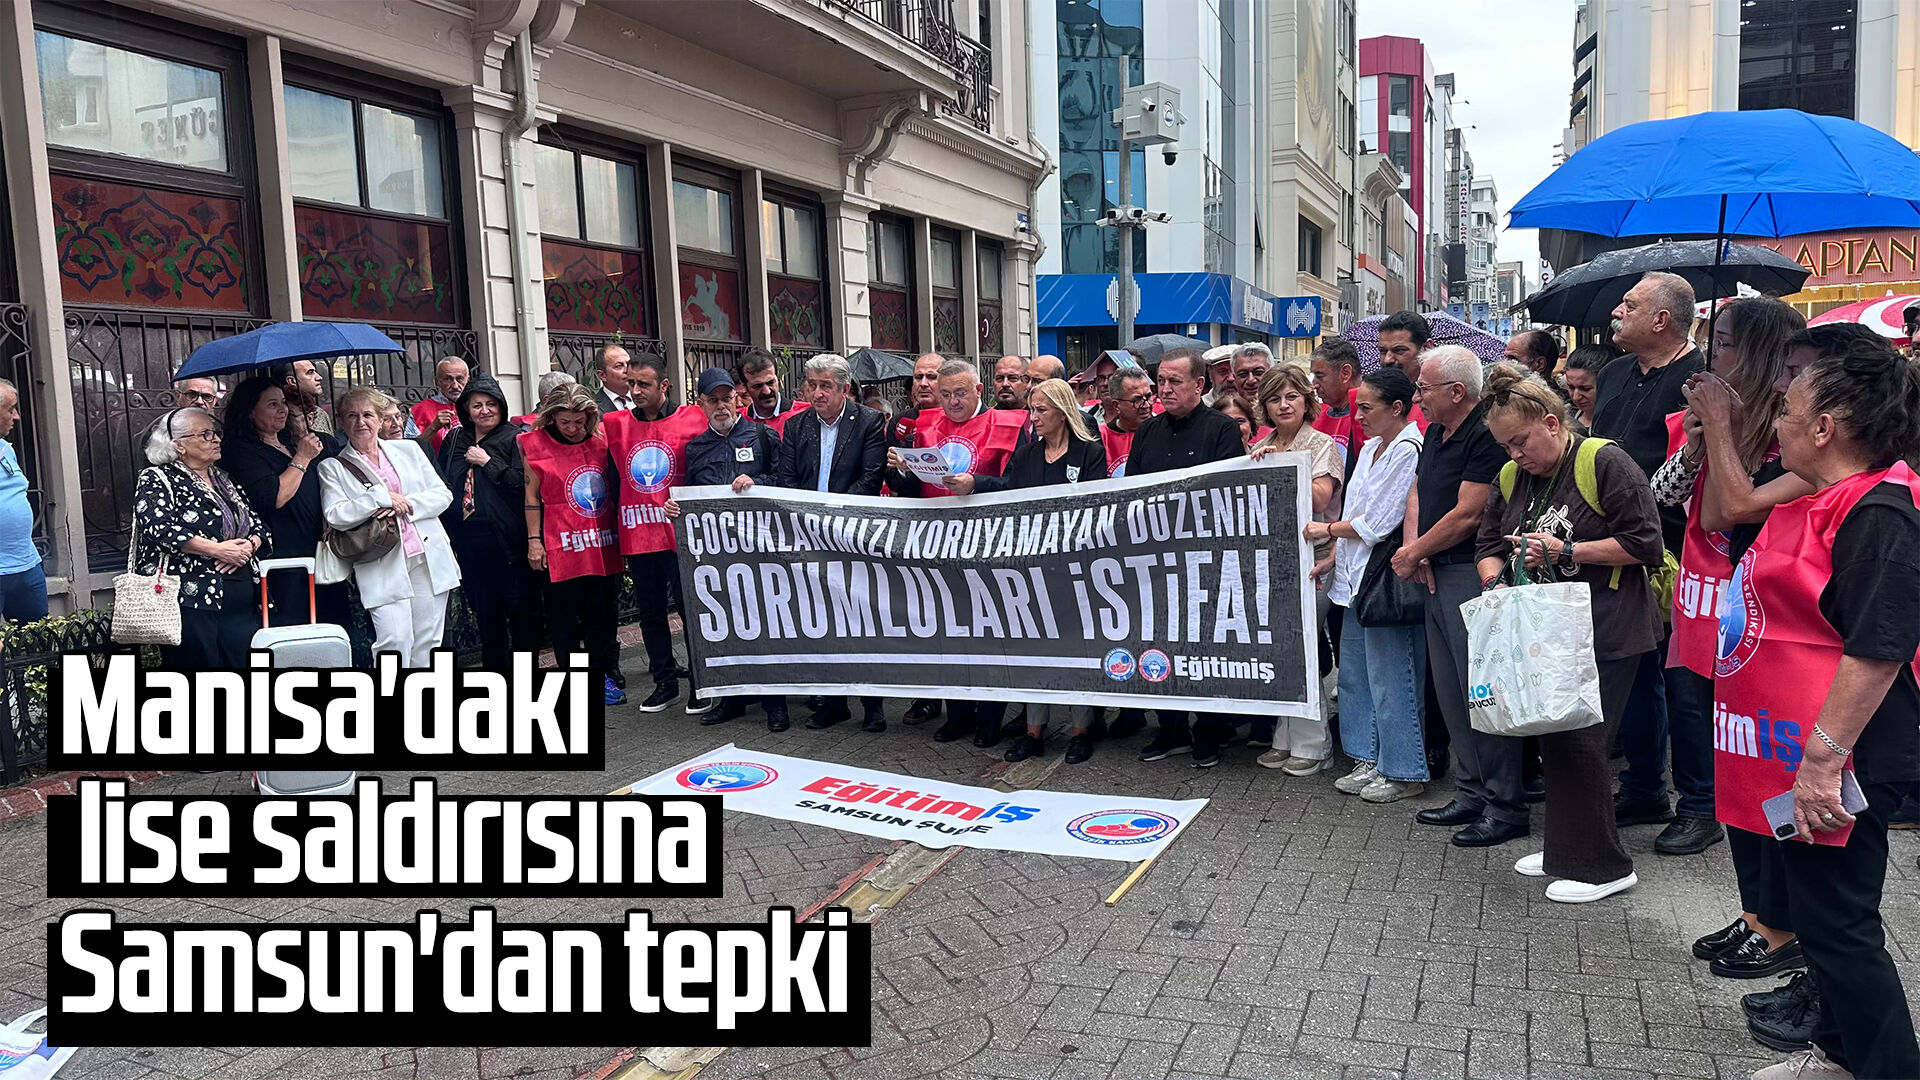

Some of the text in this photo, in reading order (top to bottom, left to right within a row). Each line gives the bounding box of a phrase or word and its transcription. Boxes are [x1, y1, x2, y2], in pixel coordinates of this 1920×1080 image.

[1774, 235, 1918, 277] APTAN
[685, 511, 898, 563] ÇOCUKLARIMIZI
[902, 504, 1118, 559] KORUYAMAYAN
[693, 560, 1060, 643] SORUMLULARI
[1173, 655, 1276, 684] Eğitimiş
[1714, 700, 1803, 773] timiş
[794, 800, 912, 827] SAMSUN
